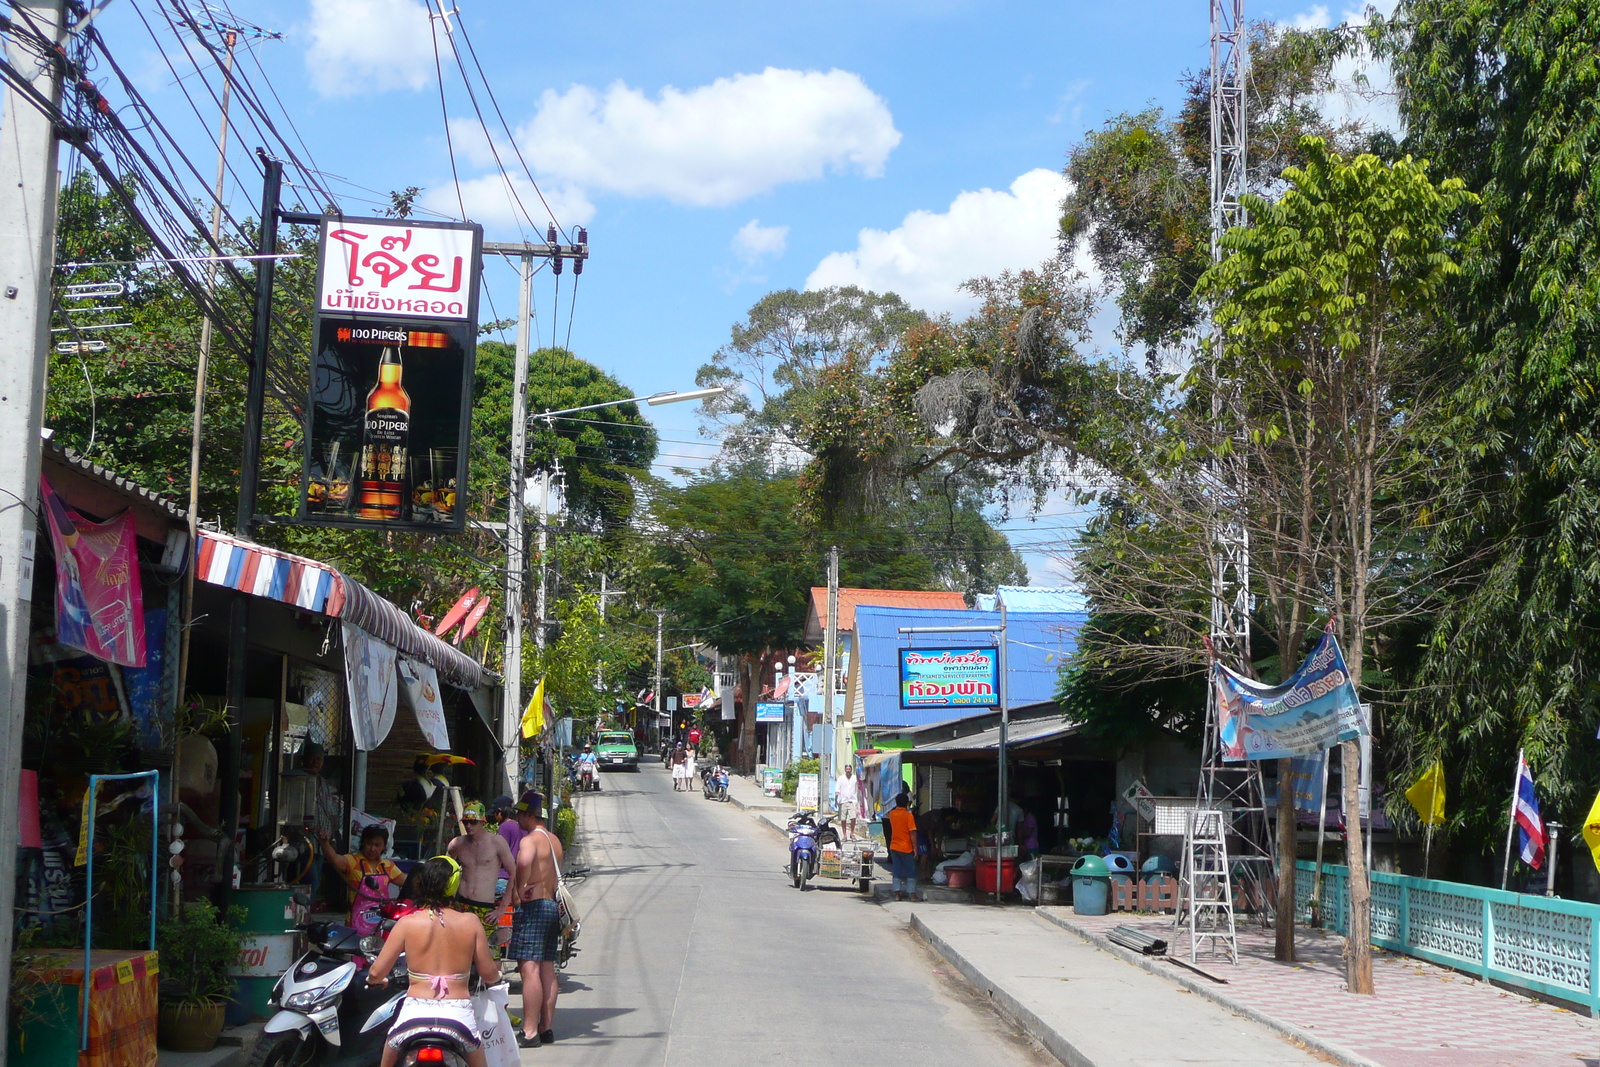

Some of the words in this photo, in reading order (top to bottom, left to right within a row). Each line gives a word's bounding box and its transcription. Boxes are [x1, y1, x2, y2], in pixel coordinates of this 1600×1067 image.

[326, 289, 463, 315] น้ำแข็งหลอด
[352, 329, 370, 339] 100
[371, 328, 407, 341] PIPERS
[378, 420, 408, 431] PIPERS
[908, 680, 992, 697] ห้องพัก
[972, 696, 982, 704] 24
